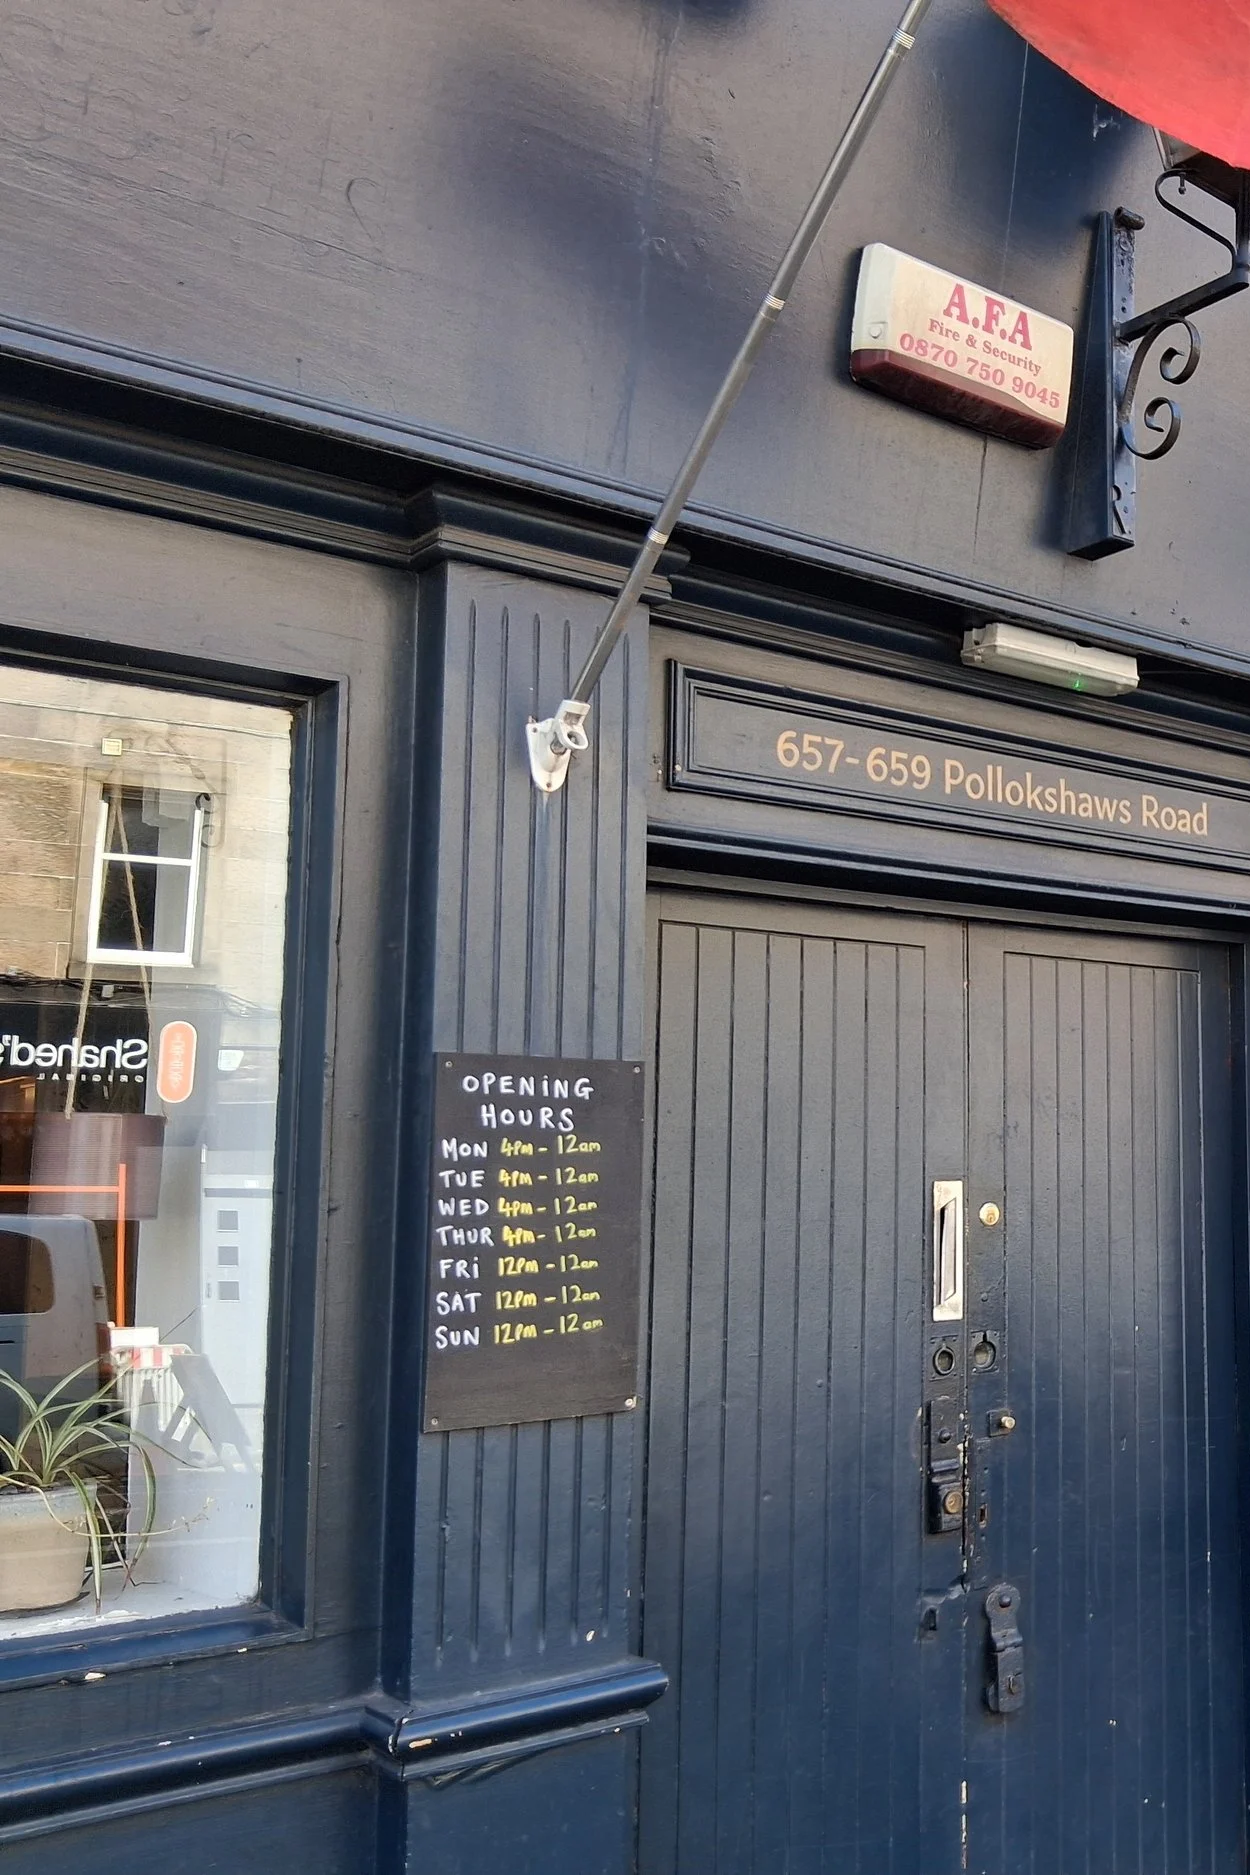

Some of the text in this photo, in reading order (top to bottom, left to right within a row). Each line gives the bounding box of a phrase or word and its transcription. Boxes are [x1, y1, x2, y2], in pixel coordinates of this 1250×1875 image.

[943, 283, 1032, 350] A.F.A
[929, 318, 1042, 377] Fire & Security
[899, 333, 1060, 409] 0870 750 9045
[776, 729, 1208, 837] 657-659 Pollokshaws Road
[481, 1104, 575, 1132] HOURS
[442, 1138, 488, 1161] MON
[439, 1170, 485, 1188] TUE
[438, 1197, 490, 1216] WED
[436, 1226, 494, 1247] THUR
[436, 1291, 482, 1315] SAT
[435, 1325, 480, 1350] SUN
